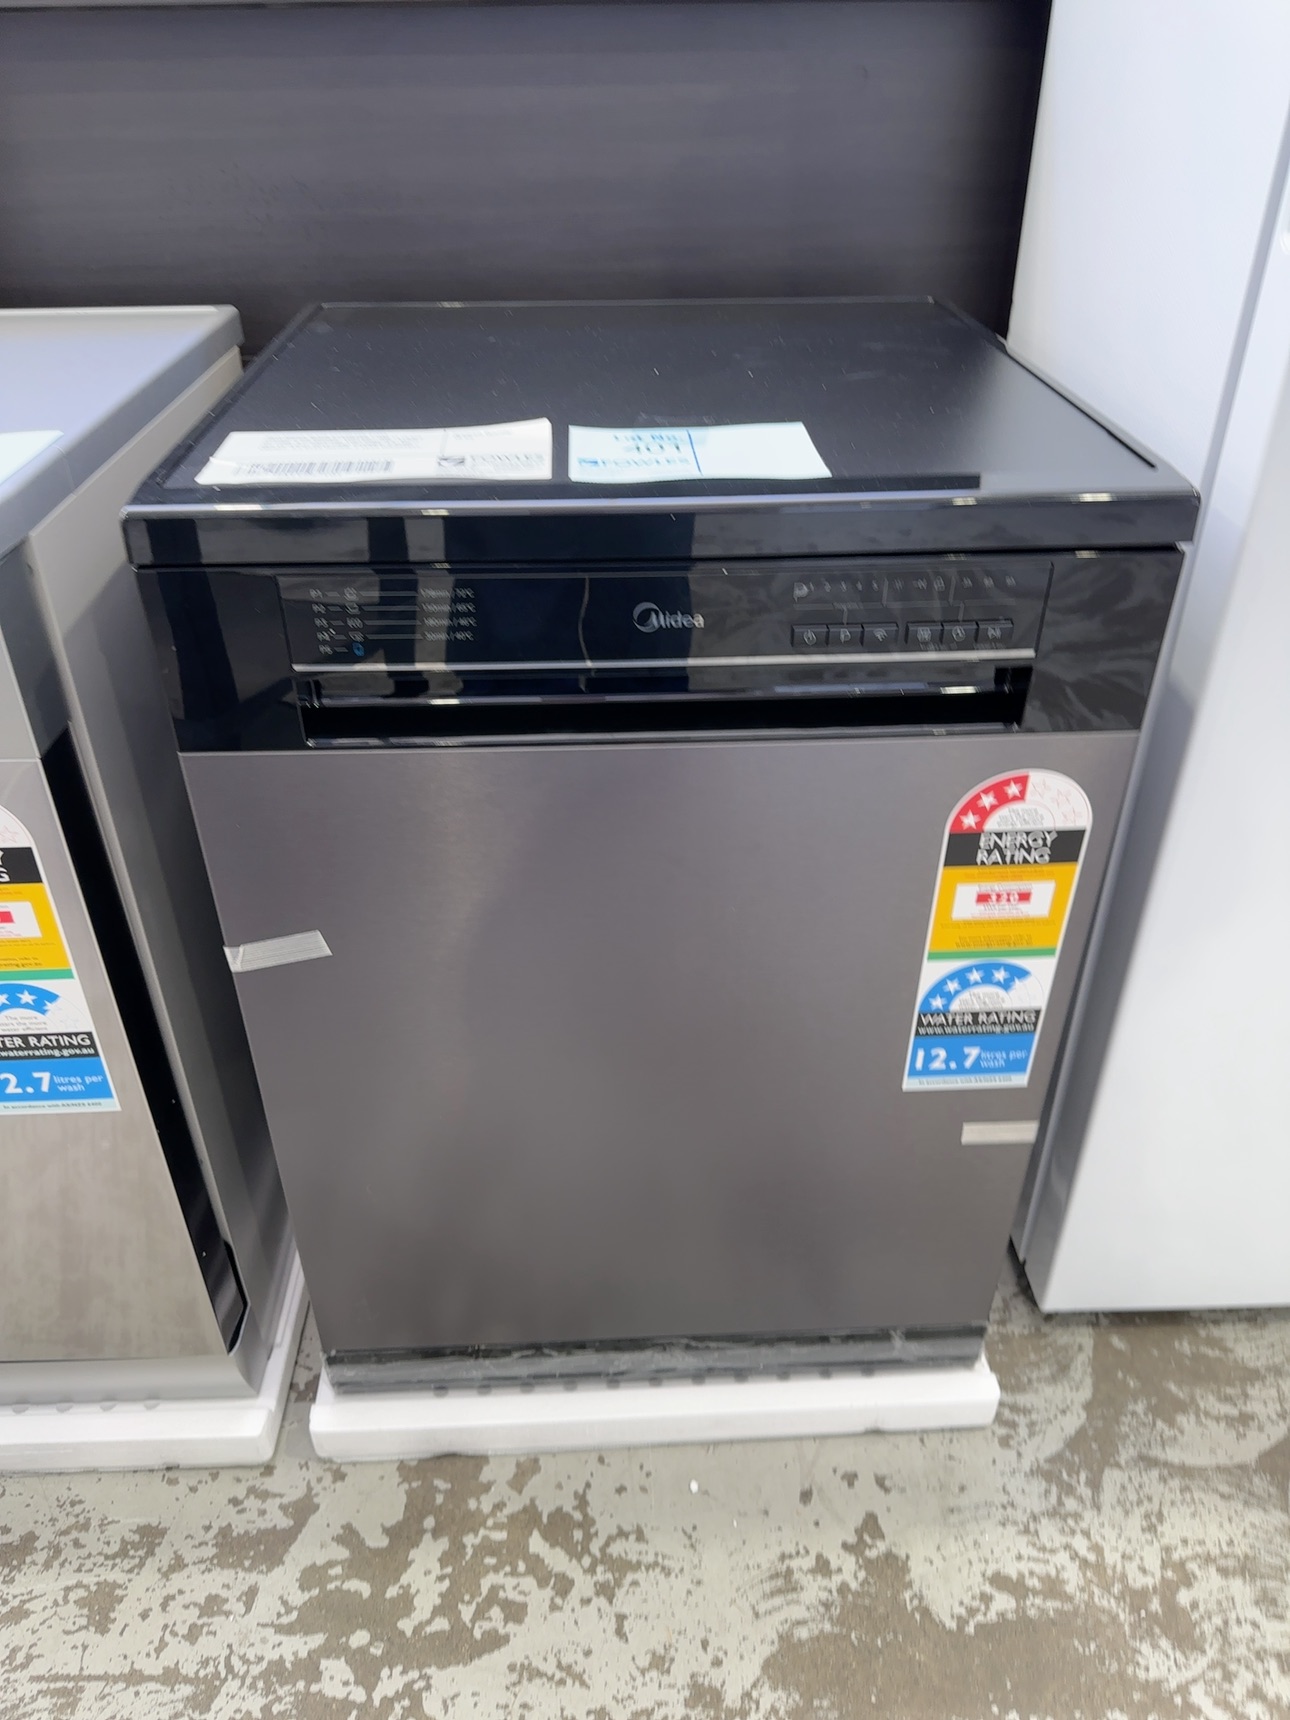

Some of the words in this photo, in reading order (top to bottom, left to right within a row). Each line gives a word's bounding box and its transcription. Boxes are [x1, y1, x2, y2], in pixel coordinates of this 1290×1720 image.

[637, 604, 704, 631] Midea
[979, 830, 1058, 849] ENERGY
[976, 847, 1051, 865] RATING
[920, 1012, 973, 1026] WATER
[978, 1010, 1036, 1024] RATING
[28, 1034, 91, 1047] RATING
[915, 1046, 981, 1071] 12.7
[53, 1075, 82, 1084] litres
[84, 1075, 103, 1085] per
[57, 1083, 85, 1092] wash
